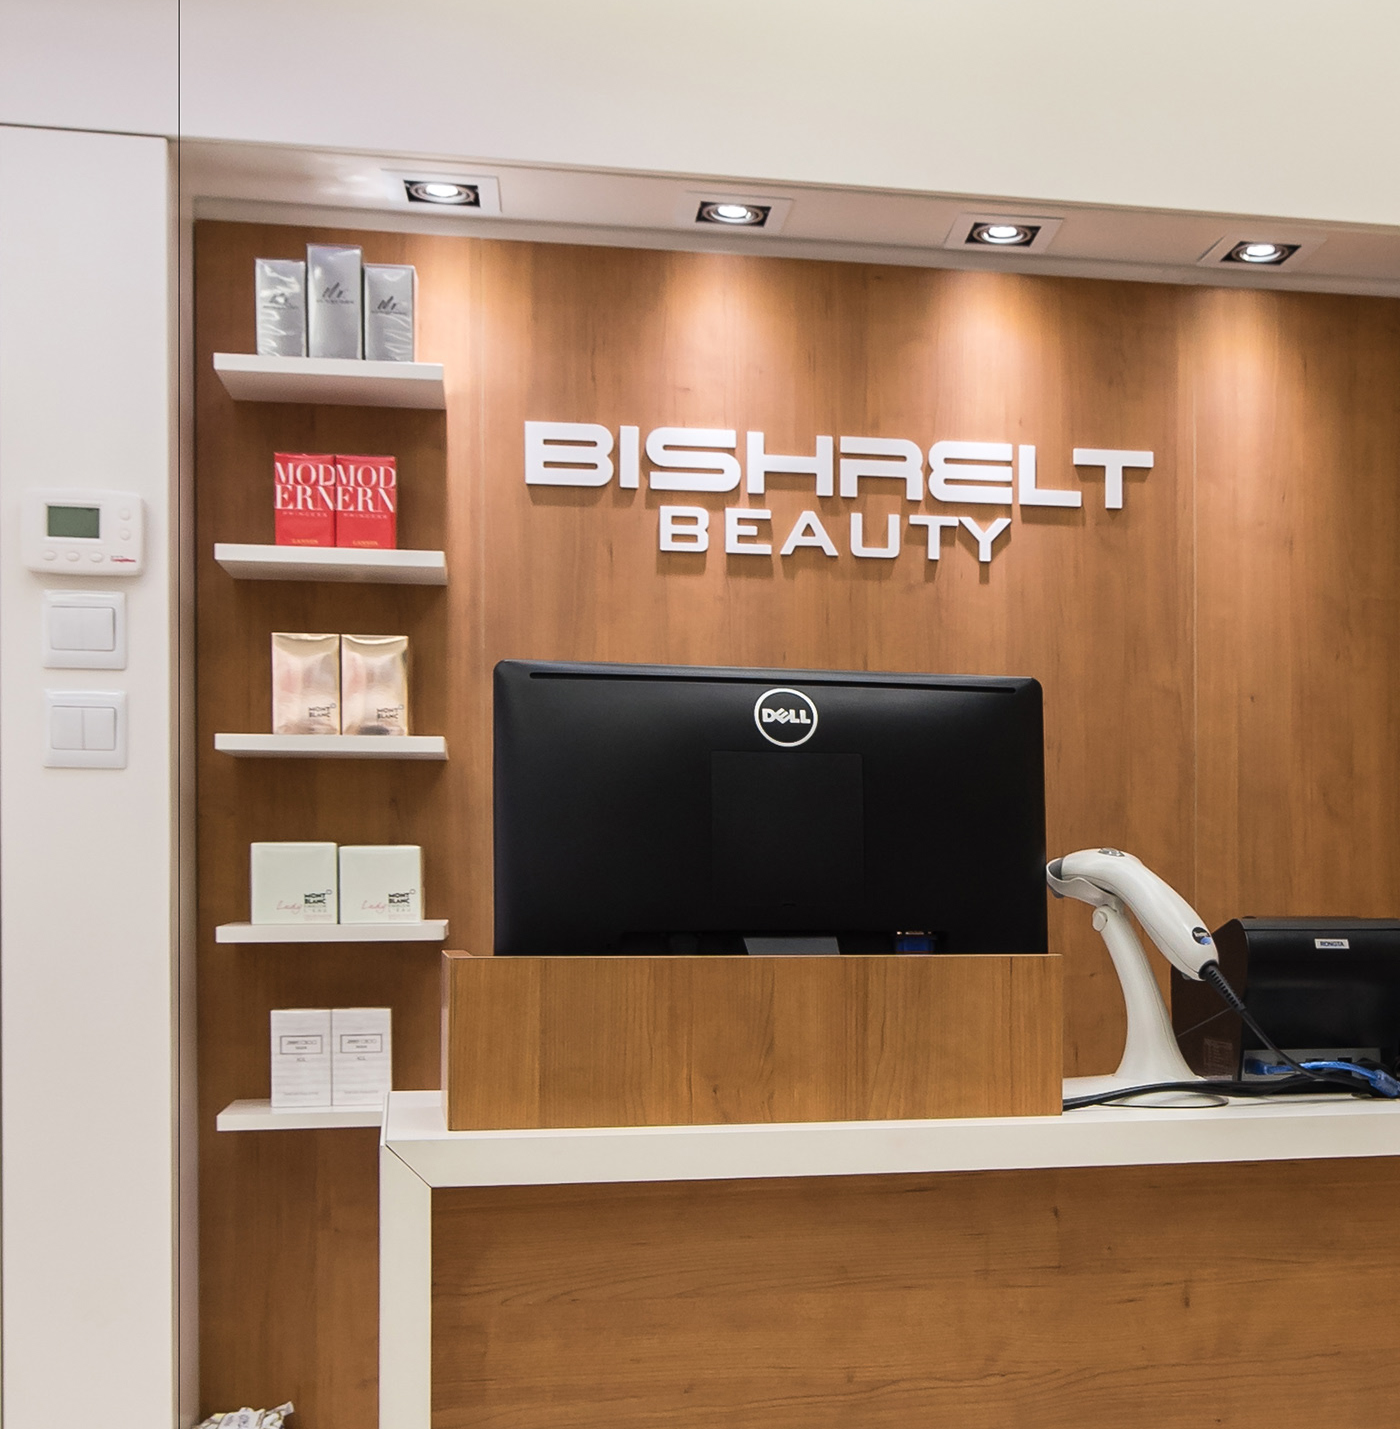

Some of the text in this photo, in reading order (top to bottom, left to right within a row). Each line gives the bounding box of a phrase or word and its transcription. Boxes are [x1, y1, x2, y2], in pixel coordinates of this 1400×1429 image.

[523, 420, 1155, 510] BISHRELT
[658, 505, 1012, 564] BEAUTY
[761, 707, 811, 724] DELL
